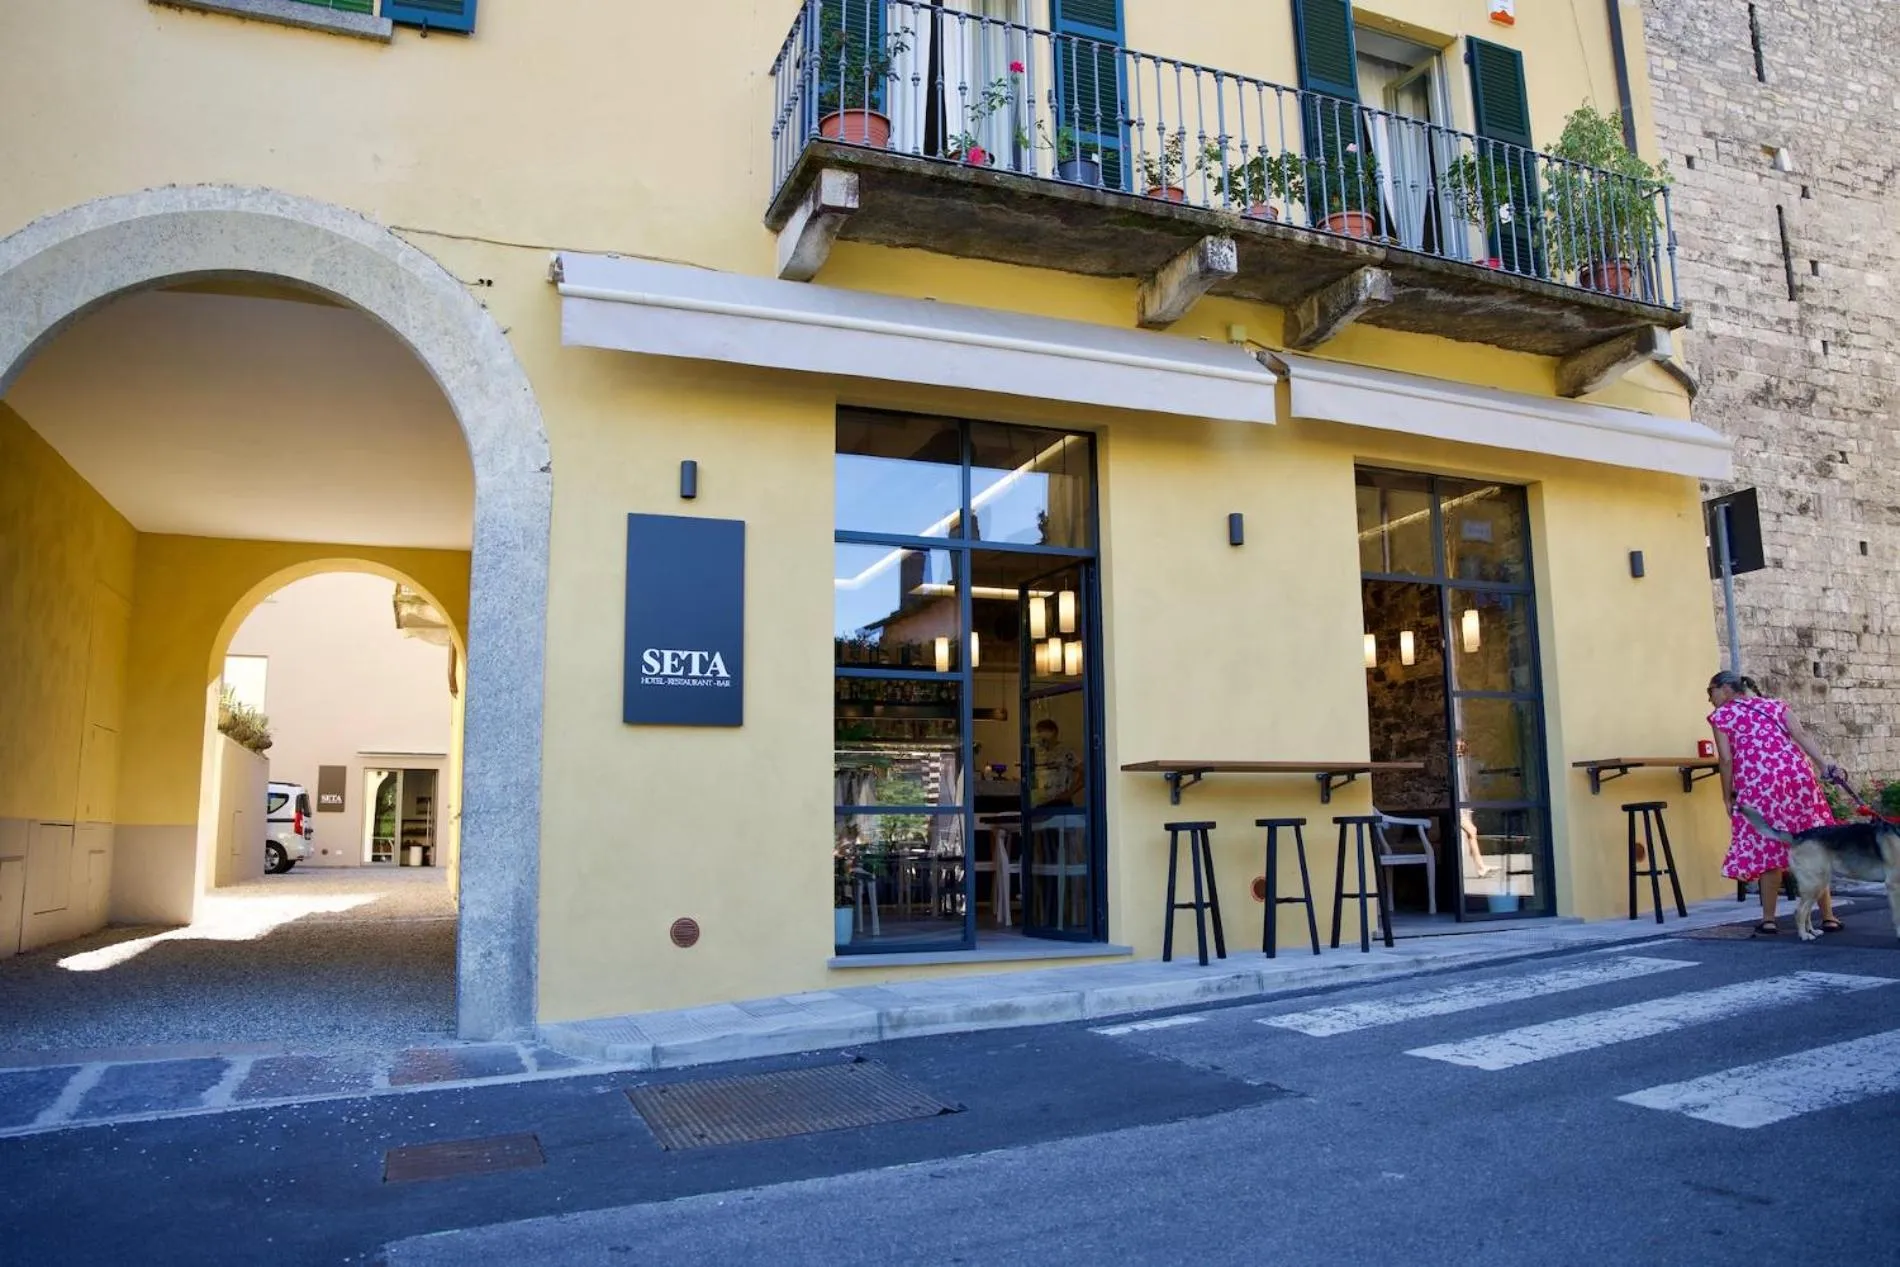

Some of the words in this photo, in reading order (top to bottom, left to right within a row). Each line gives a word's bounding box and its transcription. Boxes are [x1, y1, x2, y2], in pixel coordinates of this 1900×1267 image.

[641, 648, 730, 678] SETA
[641, 677, 665, 685] HOTEL
[667, 677, 713, 687] RESTAURANT
[716, 679, 731, 687] BAR
